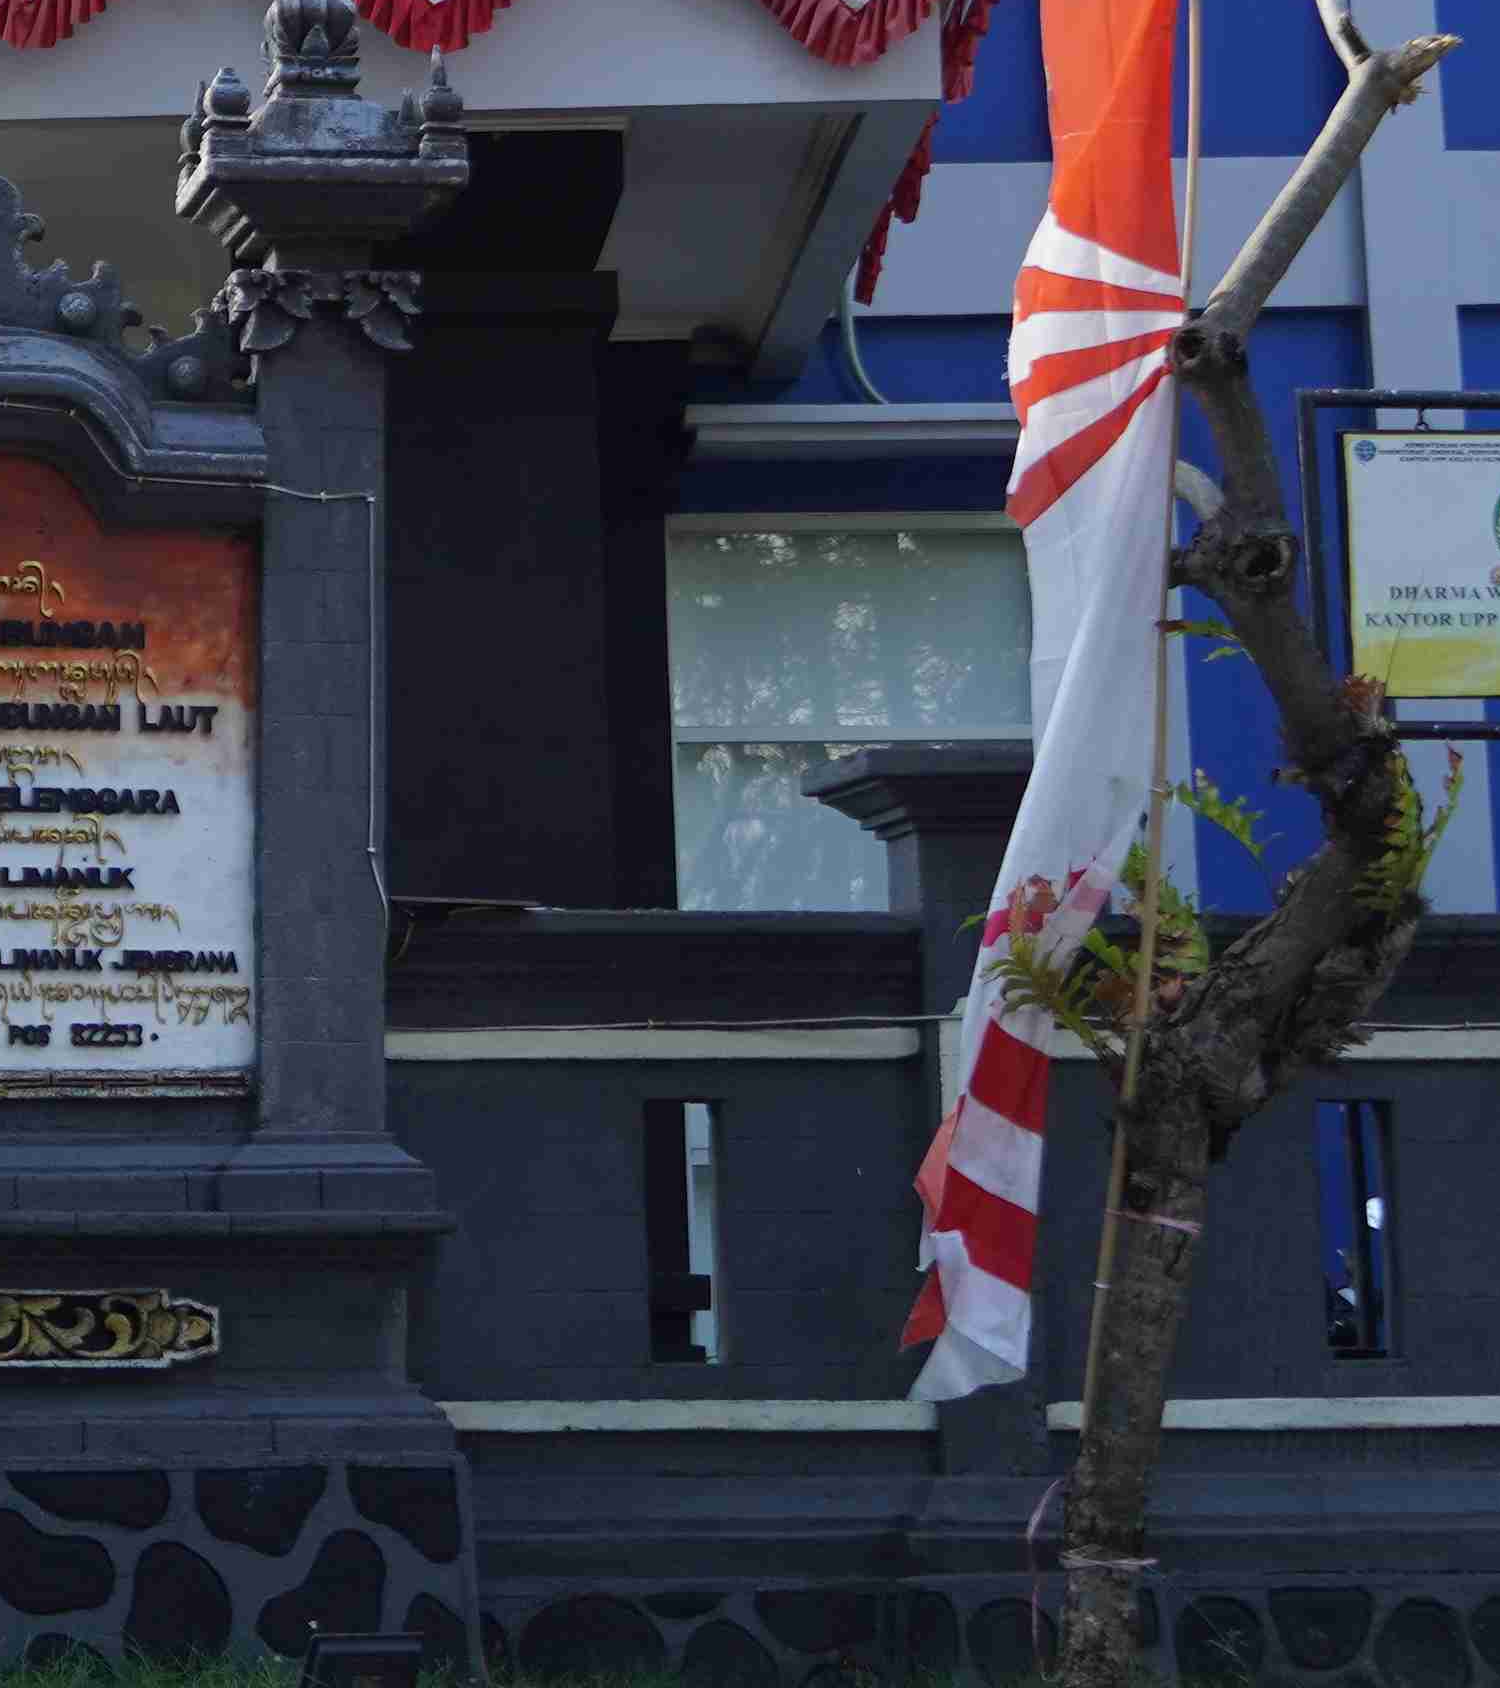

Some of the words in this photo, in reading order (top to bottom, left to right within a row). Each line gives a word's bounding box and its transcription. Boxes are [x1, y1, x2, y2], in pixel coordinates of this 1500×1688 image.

[1390, 586, 1480, 601] DHARMA
[1365, 613, 1451, 628] KANTOR
[1458, 613, 1498, 628] UPP
[137, 705, 219, 735] LAUT
